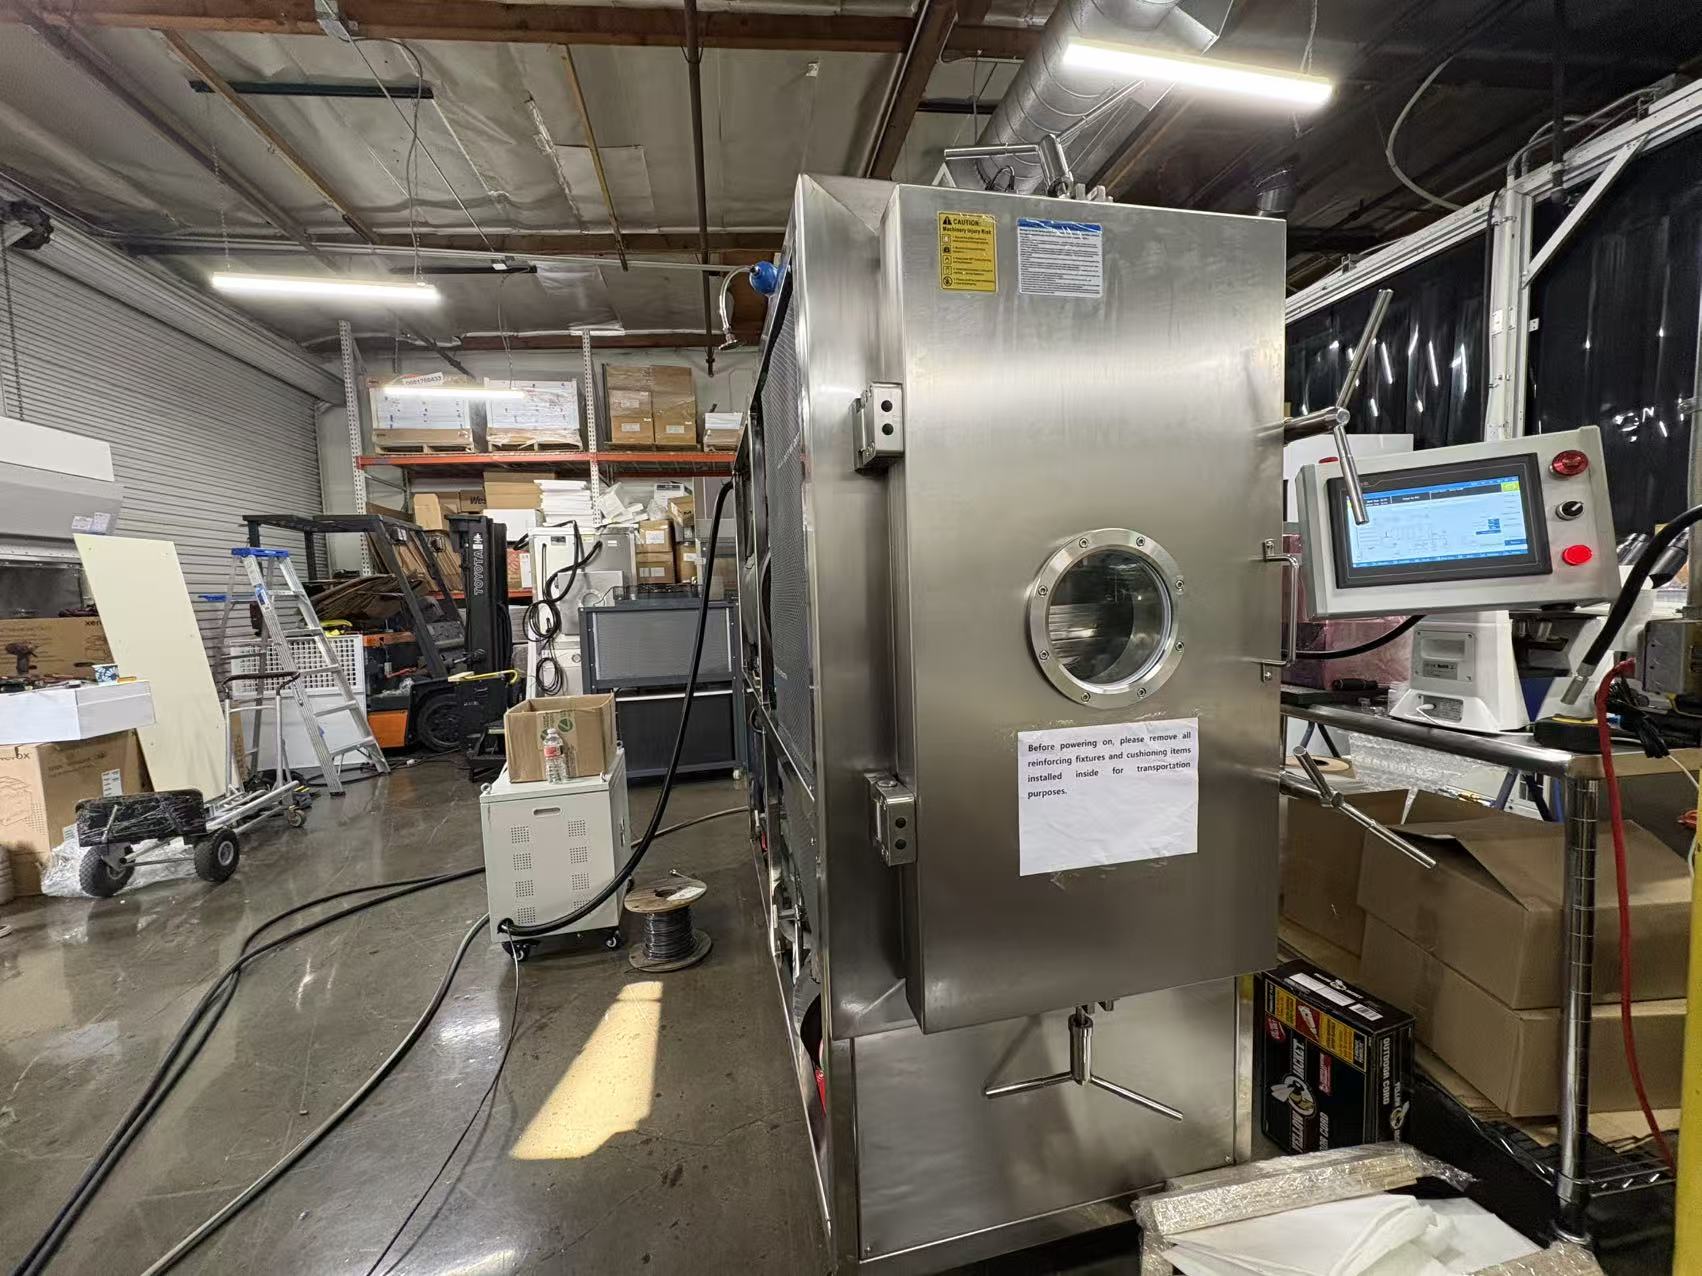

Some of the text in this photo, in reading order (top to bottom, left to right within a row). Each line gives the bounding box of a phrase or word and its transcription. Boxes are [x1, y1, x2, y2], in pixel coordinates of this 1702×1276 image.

[942, 226, 967, 235] Machinery
[953, 218, 979, 227] CAUTION
[473, 550, 484, 596] TOYOTA
[1028, 731, 1191, 752] Before powering on, please remove all
[1028, 746, 1192, 768] reinforcing fixtures and cushioning items
[1028, 761, 1191, 782] installed inside for transportation
[1028, 788, 1067, 799] purposes.
[1382, 1037, 1391, 1105] OUTDOOR CORD
[1291, 1038, 1305, 1153] YELLOW JACKET
[1319, 1111, 1329, 1138] CORD
